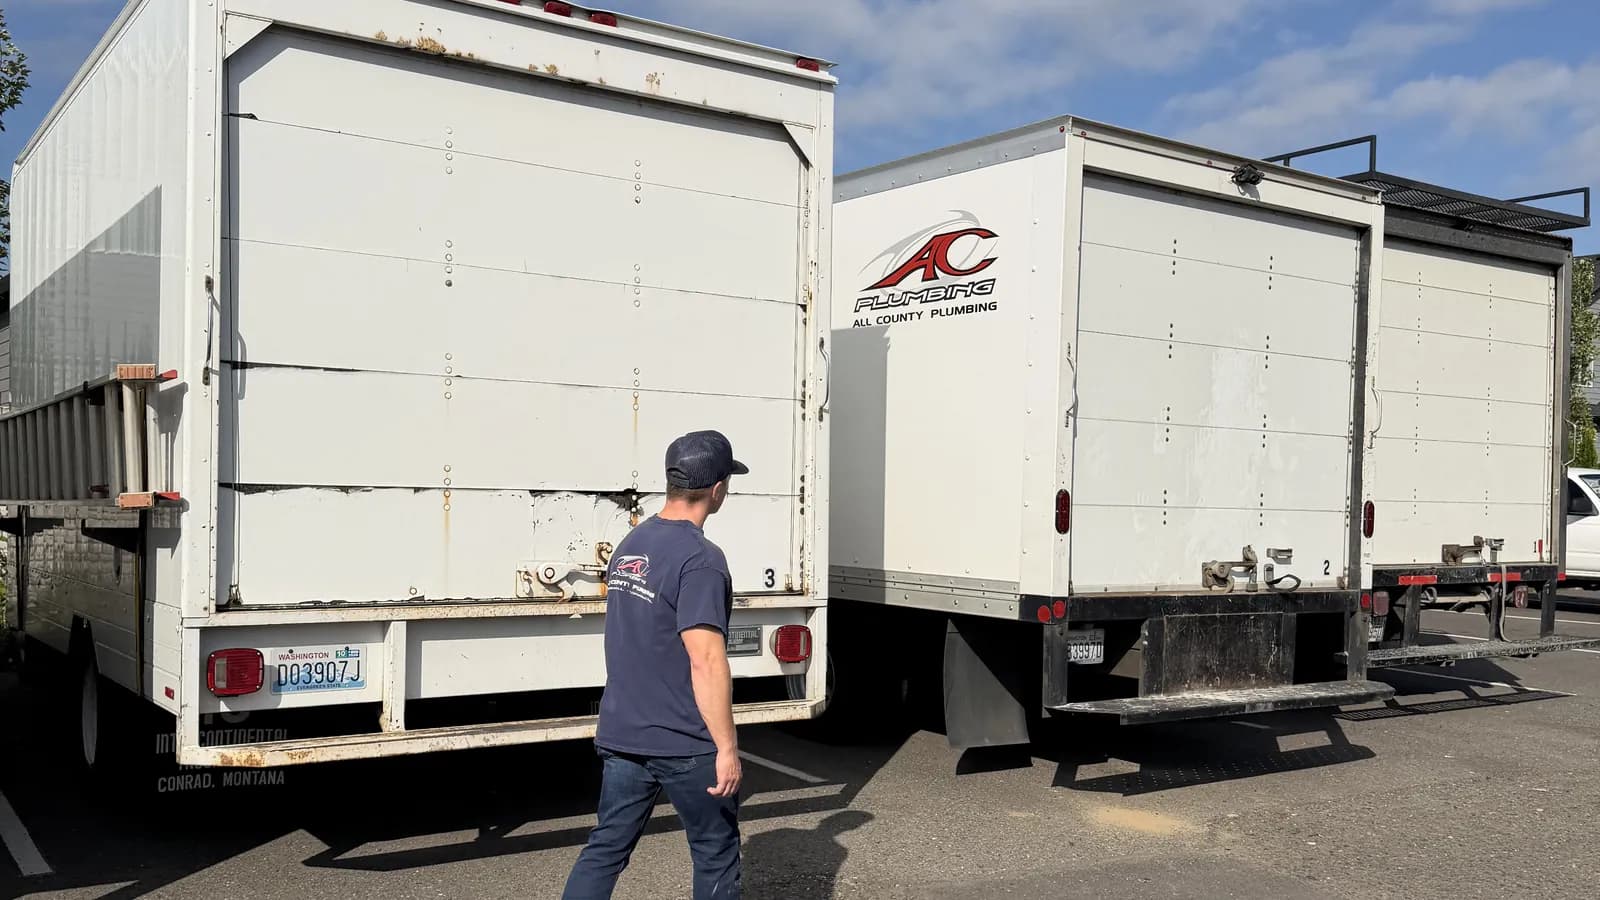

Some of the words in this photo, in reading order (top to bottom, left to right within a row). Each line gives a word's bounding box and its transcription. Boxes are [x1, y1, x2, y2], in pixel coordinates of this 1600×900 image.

[860, 228, 999, 292] AC
[854, 278, 997, 313] PLUMBING
[853, 318, 872, 328] ALL
[876, 310, 924, 325] COUNTY
[931, 301, 998, 318] PLUMBING
[1323, 560, 1331, 575] 2
[764, 568, 776, 588] 3
[278, 651, 330, 661] WASHINGTON
[222, 770, 285, 787] MONTANA
